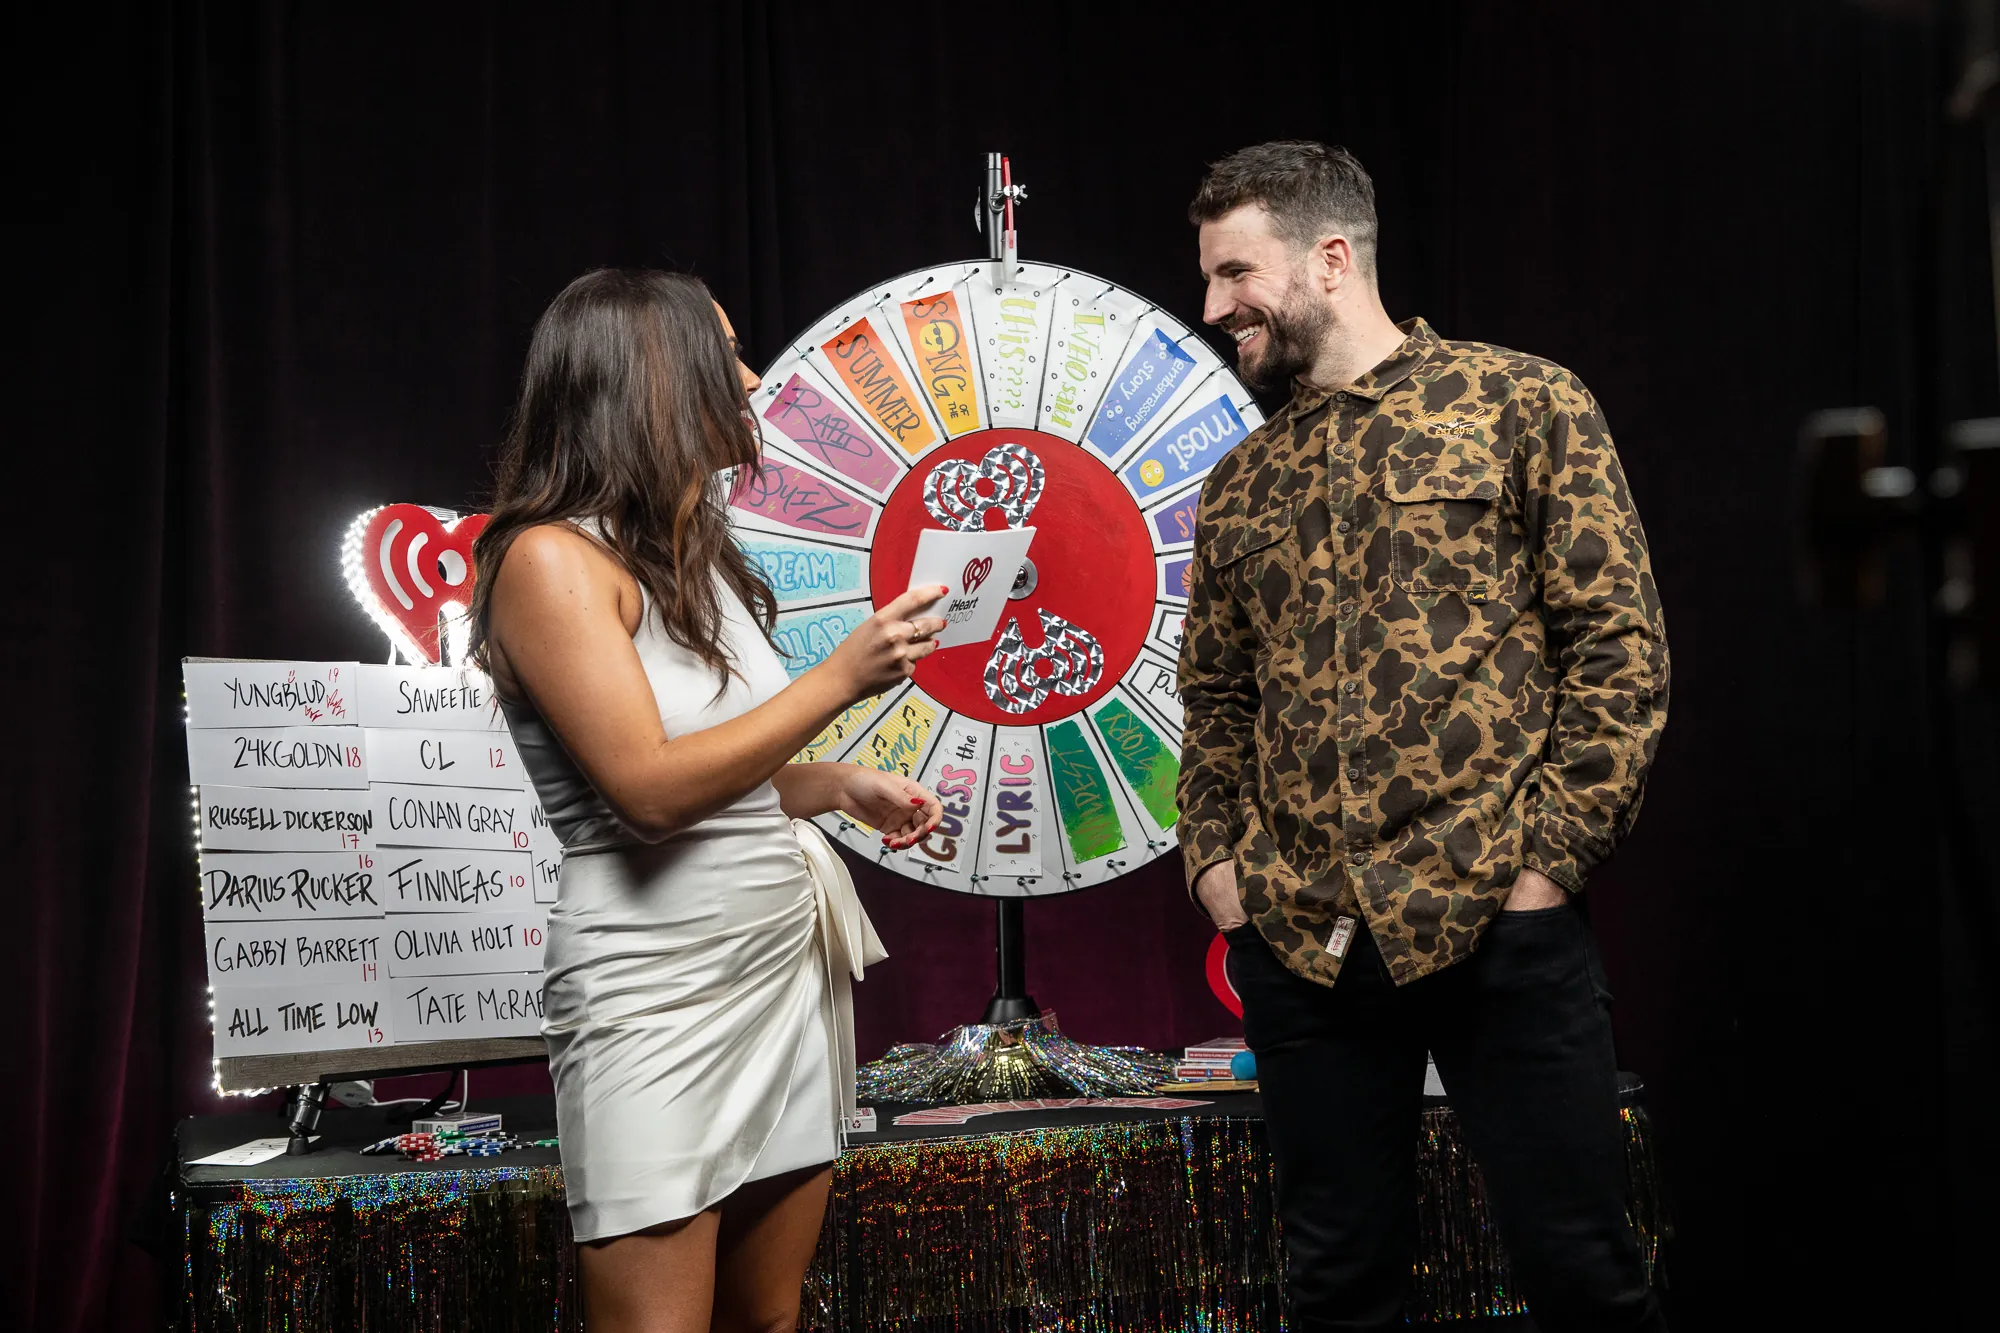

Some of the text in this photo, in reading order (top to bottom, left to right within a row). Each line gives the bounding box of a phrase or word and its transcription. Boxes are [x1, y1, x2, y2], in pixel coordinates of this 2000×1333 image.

[835, 333, 921, 443] SUMMER
[1119, 360, 1155, 400] story
[1124, 358, 1186, 433] embarrassing
[948, 402, 959, 419] THE
[959, 404, 969, 417] OF
[1051, 382, 1078, 429] said
[784, 387, 874, 470] RAPID
[1166, 407, 1239, 473] most
[1435, 427, 1451, 436] EST
[748, 463, 862, 531] QUIZ
[944, 609, 974, 625] RADIO
[948, 596, 979, 613] iHeart
[224, 678, 326, 709] YUNGBLUD
[328, 667, 340, 684] 19
[396, 680, 482, 714] SAWEETIE
[233, 736, 362, 769] 24KGOLDN 18
[420, 739, 506, 771] CL 12
[389, 797, 462, 830] CONAN
[467, 807, 515, 834] GRAY
[918, 734, 978, 863] GUESS the
[995, 754, 1035, 855] LYRIC
[208, 805, 373, 834] RUSSELL DICKERSON
[342, 832, 360, 850] 17
[513, 831, 529, 849] 10
[358, 854, 374, 870] 16
[203, 867, 379, 913] DARIUS RUCKER
[388, 858, 526, 905] FINNEAS 10
[213, 936, 380, 973] GABBY BARRETT
[394, 924, 543, 961] OLIVIA HOLT 10
[362, 963, 378, 982] 14
[228, 1001, 379, 1039] ALL TIME LOW
[406, 986, 468, 1026] TATE
[367, 1028, 384, 1044] 13
